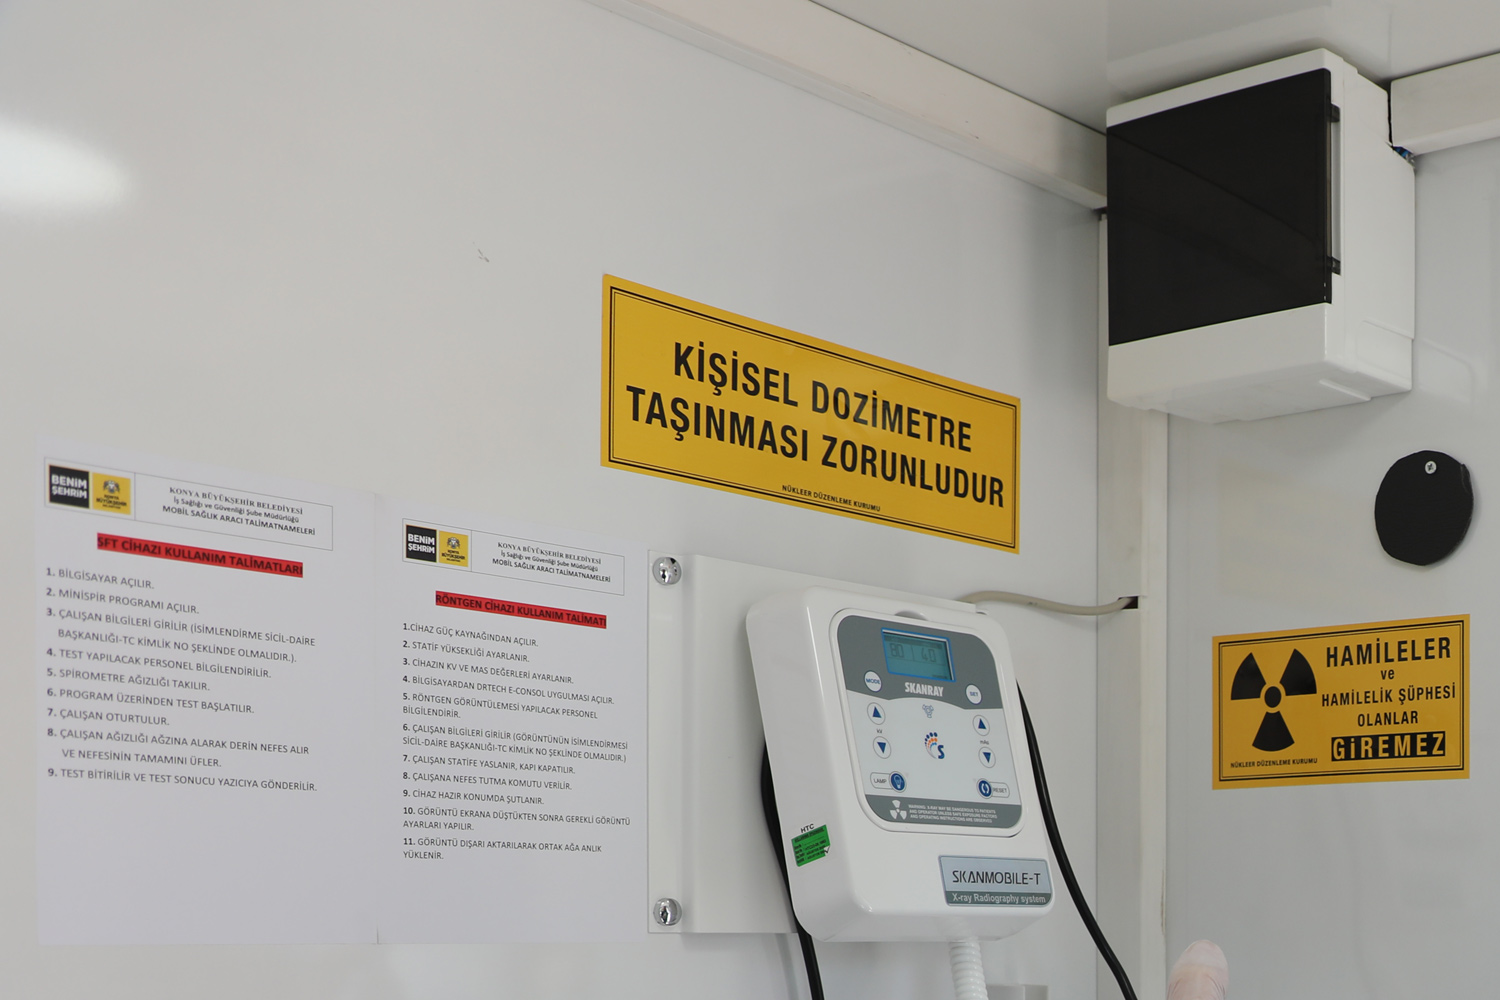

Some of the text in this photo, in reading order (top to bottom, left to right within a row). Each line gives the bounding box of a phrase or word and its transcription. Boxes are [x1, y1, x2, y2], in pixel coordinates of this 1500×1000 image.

[674, 341, 972, 453] KİŞİSEL DOZİMETRE
[626, 385, 1004, 508] TAŞINMASI ZORUNLUDUR
[51, 474, 87, 489] BENİM
[51, 485, 87, 499] ŞEHRİM
[170, 487, 200, 498] KONYA
[782, 484, 881, 512] NÜKLEER DÜZENLEME KURUMU
[162, 505, 188, 515] MOBİL
[190, 510, 218, 520] SAĞLIK
[220, 515, 244, 524] ARACI
[407, 533, 435, 546] BENİM
[407, 542, 435, 554] ŞEHRİM
[98, 537, 303, 575] SFT CİHAZI KULLANIM TALİMATLARI
[46, 567, 155, 588] 1. BİLGİSAYAR AÇILIR.
[46, 587, 200, 613] 2. MİNİSPİR PROGRAMI AÇILIR.
[437, 595, 607, 627] RÖNTGEN CİHAZI KULLANIM TALİMATI
[46, 607, 315, 646] 3. ÇALIŞAN BİLGİLERİ GİRİLİR (İSİMLENDİRME SİCİL-DAİRE
[403, 623, 434, 634] 1.CİHAZ
[435, 626, 453, 637] GÜÇ
[513, 637, 539, 646] AÇILIR.
[58, 629, 298, 663] BAŞKANLIĞI-TC KİMLİK NO ŞEKLİNDE OLMALIDIR.).
[1326, 637, 1451, 668] HAMİLELER
[46, 648, 272, 677] 4. TEST YAPILACAK PERSONEL BİLGİLENDİRİLİR.
[46, 667, 211, 690] 5. SPİROMETRE AĞIZLIĞI TAKILIR.
[1380, 668, 1395, 680] ve
[904, 682, 944, 697] SKANRAY
[1321, 682, 1456, 707] HAMİLELİK ŞÜPHESİ
[46, 688, 255, 713] 6. PROGRAM ÜZERİNDEN TEST BAŞLATILIR.
[47, 707, 170, 725] 7. ÇALIŞAN OTURTULUR.
[1357, 710, 1419, 727] OLANLAR
[403, 723, 411, 731] 6.
[412, 724, 446, 734] ÇALIŞAN
[447, 727, 484, 737] BİLGİLERİ
[484, 730, 511, 739] GİRİLİR
[47, 728, 309, 754] 8. ÇALIŞAN AĞIZLIĞI AĞZINA ALARAK DERİN NEFES ALIR
[1332, 733, 1445, 760] GİREMEZ
[62, 749, 222, 767] VE NEFESİNİN TAMAMINI ÜFLER.
[1230, 757, 1318, 768] NÜKLEER DÜZENLEME KURUMU
[47, 768, 318, 791] 9. TEST BİTİRİLİR VE TEST SONUCU YAZICIYA GÖNDERİLİR.
[403, 807, 631, 825] 10. GÖRÜNTÜ EKRANA DÜŞTÜKTEN SONRA GEREKLİ GÖRÜNTÜ
[403, 820, 475, 830] AYARLARI YAPILIR.
[800, 823, 815, 833] HTC
[403, 837, 416, 845] 11.
[417, 837, 458, 847] GÖRÜNTÜ
[460, 840, 485, 849] DIŞARI
[564, 843, 580, 851] AĞA
[403, 850, 445, 859] YÜKLENİR.
[952, 870, 1041, 885] SKANMOBILE-T
[952, 893, 1046, 905] X-ray Radiography system
